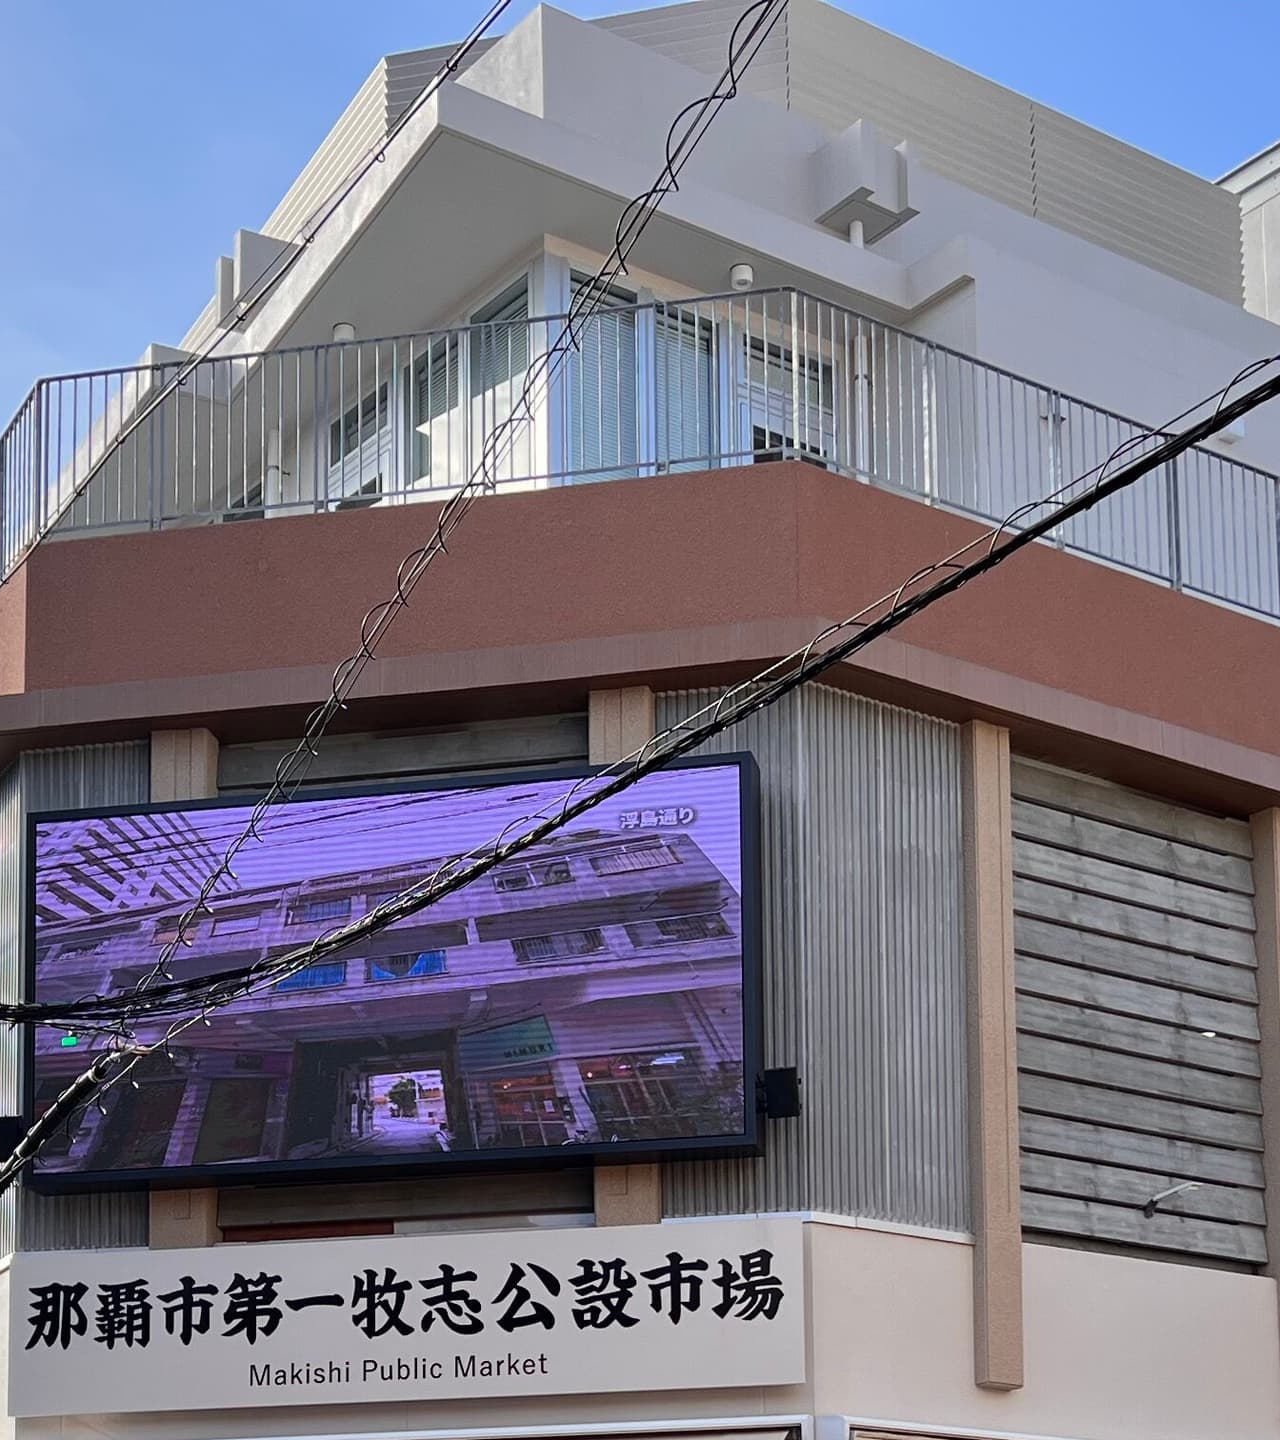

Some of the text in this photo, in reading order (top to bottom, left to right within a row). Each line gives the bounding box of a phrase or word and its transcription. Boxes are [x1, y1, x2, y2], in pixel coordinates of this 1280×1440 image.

[620, 807, 694, 829] 浮島通り
[24, 1248, 785, 1351] 那覇市第一牧志公設市場
[249, 1352, 549, 1387] Makishi Public Market
